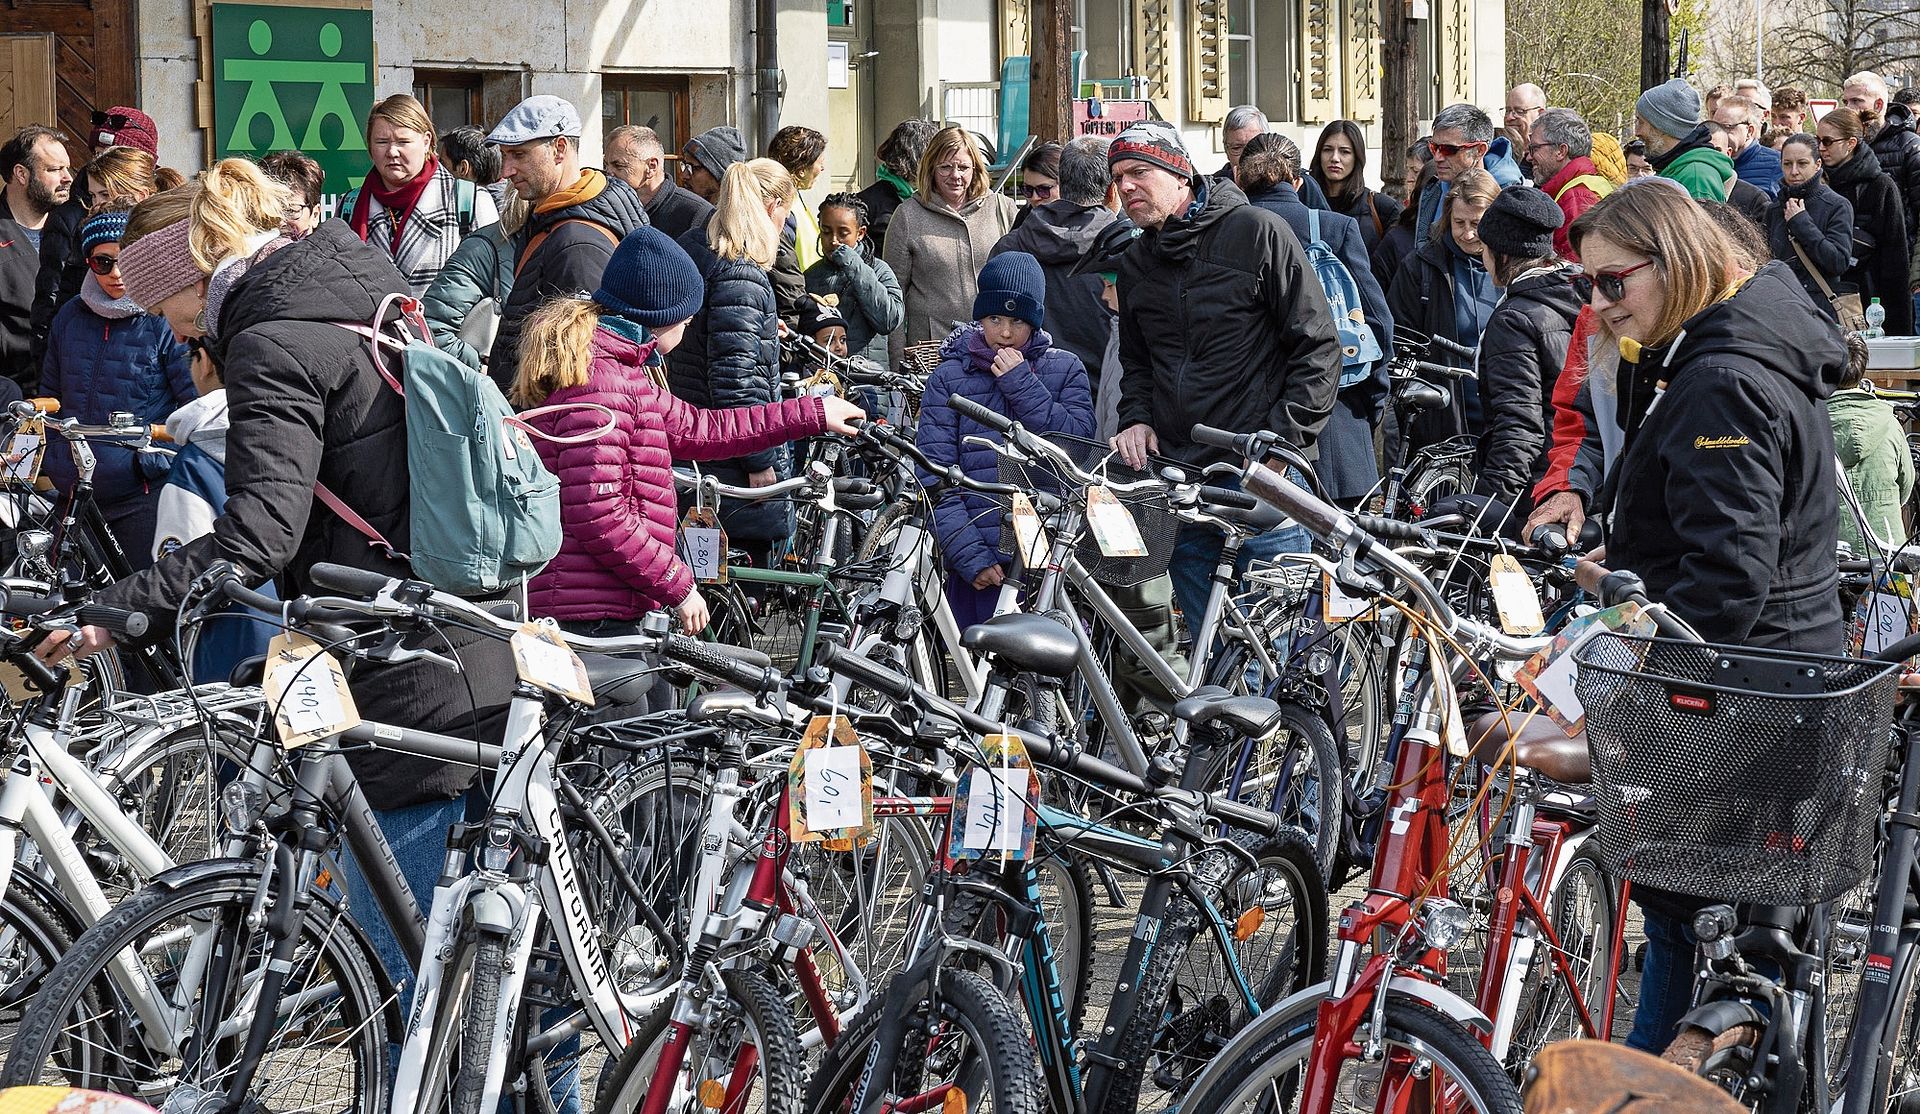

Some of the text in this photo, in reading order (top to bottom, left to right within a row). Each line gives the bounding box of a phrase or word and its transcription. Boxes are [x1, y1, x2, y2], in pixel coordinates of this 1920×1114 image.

[549, 808, 608, 988] CALIFORNIA
[1879, 924, 1898, 936] GOYA
[838, 1006, 886, 1061] SCHW
[1250, 1033, 1288, 1064] SCHWALBE
